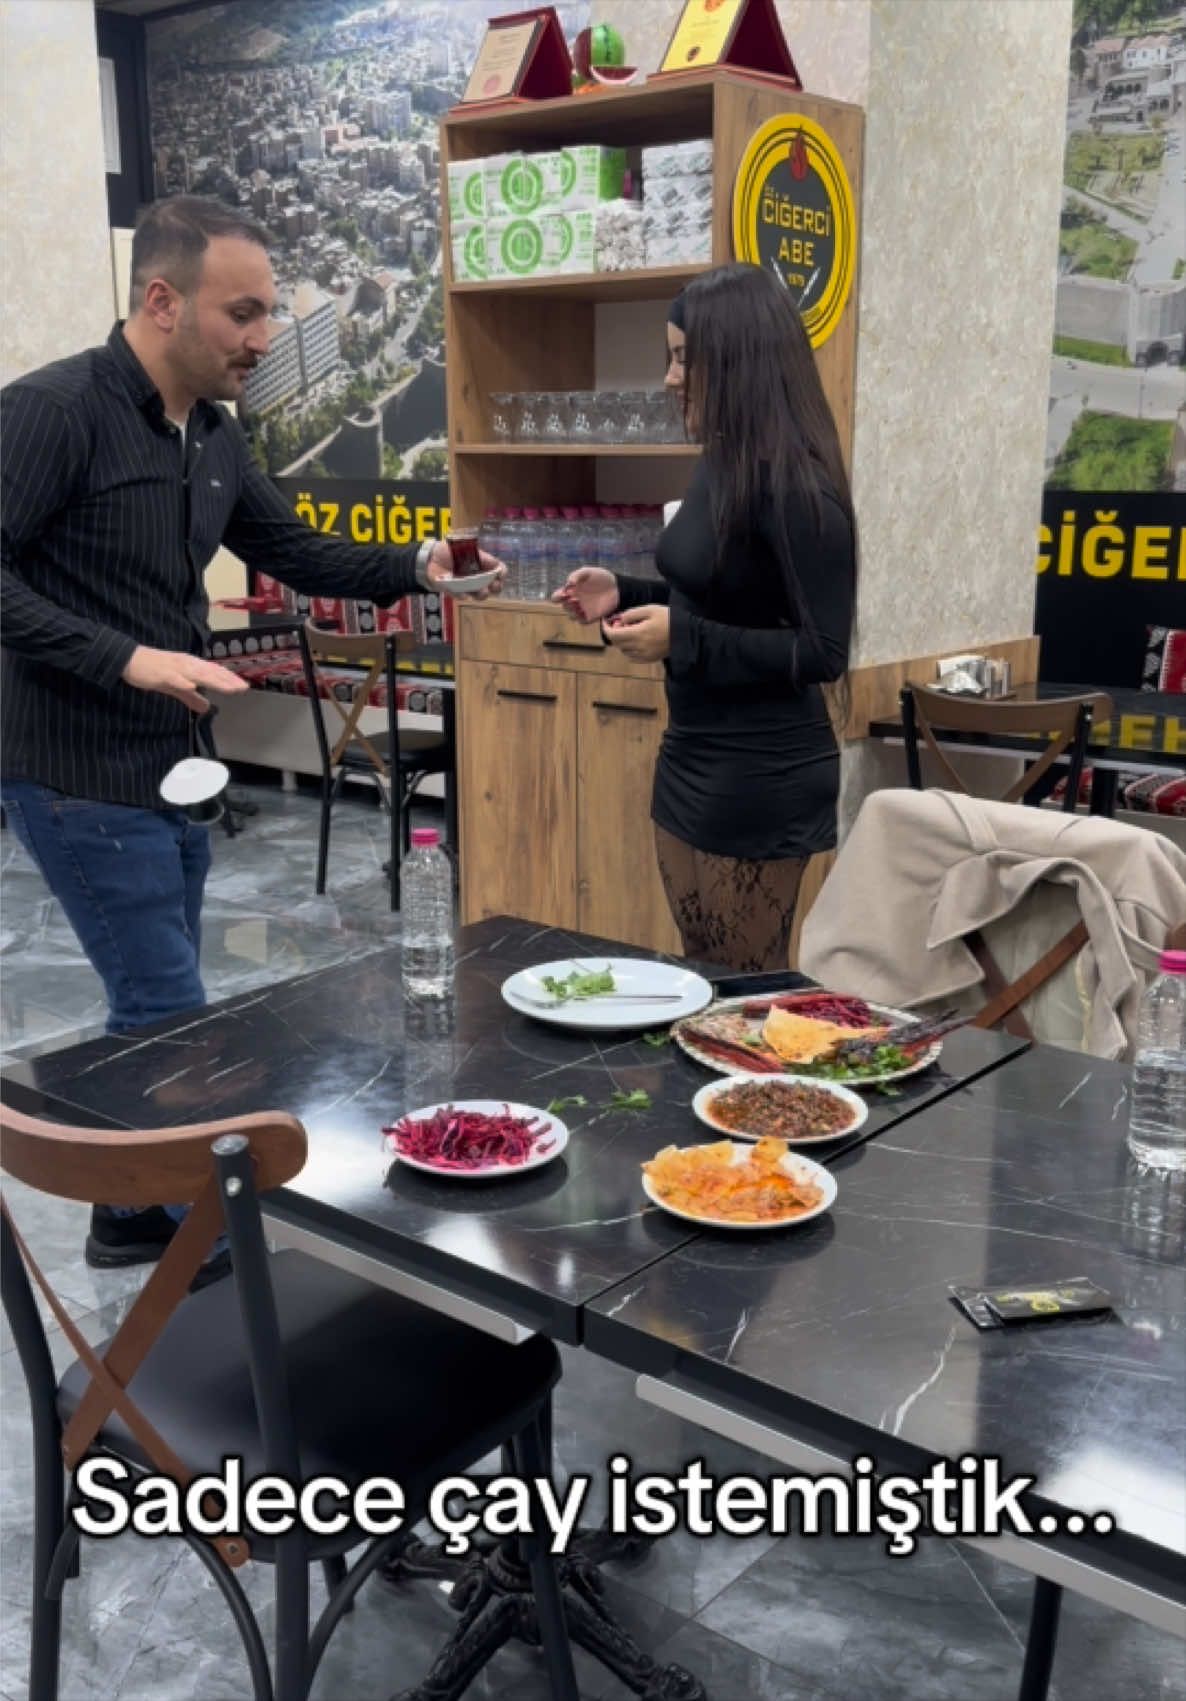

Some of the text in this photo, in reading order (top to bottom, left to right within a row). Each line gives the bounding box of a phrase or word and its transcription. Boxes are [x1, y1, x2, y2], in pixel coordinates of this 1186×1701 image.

[763, 193, 830, 236] CİĞERCİ
[778, 237, 814, 266] ABE
[295, 492, 340, 536] ÖZ
[1035, 510, 1186, 581] İĞE
